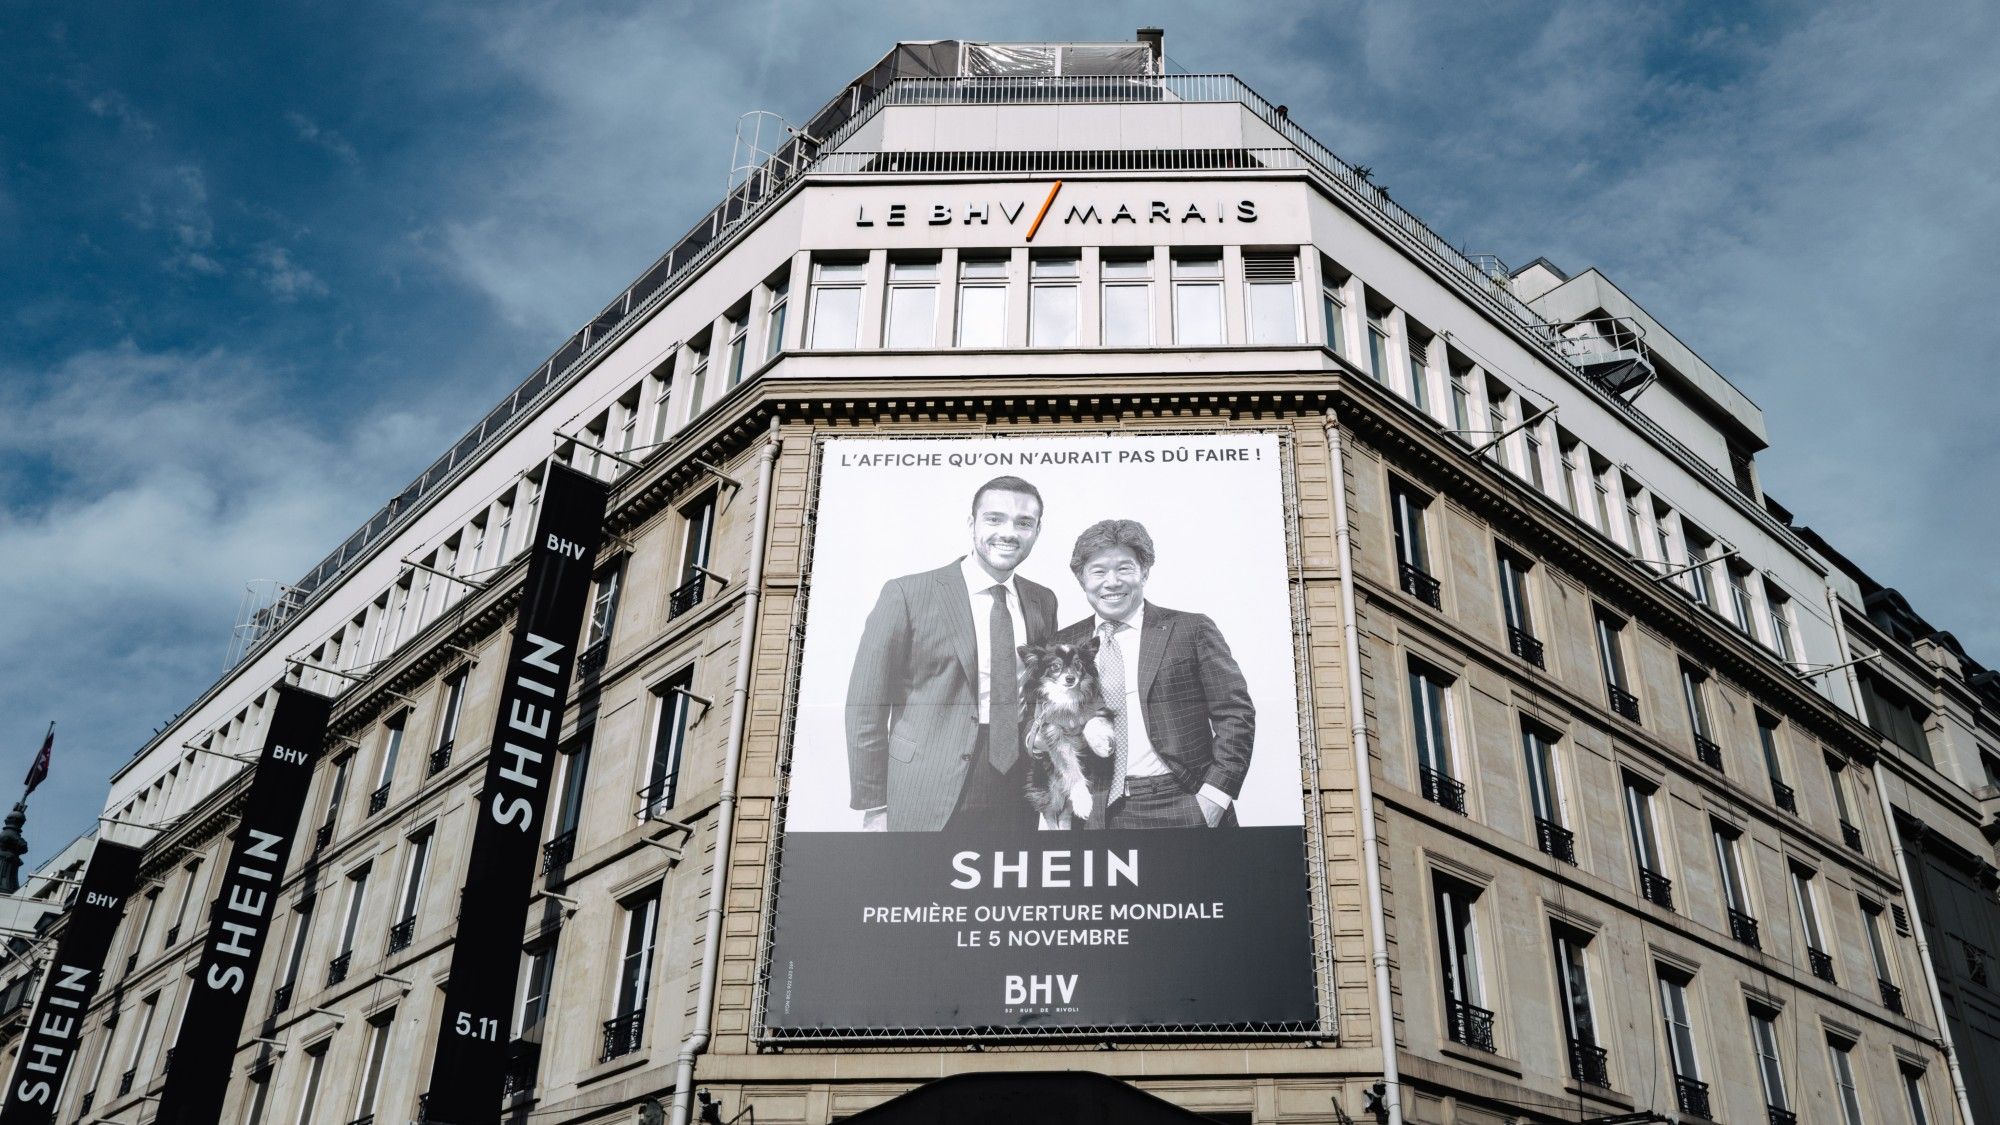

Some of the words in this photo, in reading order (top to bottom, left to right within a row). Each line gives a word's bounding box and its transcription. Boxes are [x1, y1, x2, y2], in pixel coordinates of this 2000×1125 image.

[856, 204, 906, 227] LE
[841, 453, 942, 467] L'AFFICHE
[948, 453, 1013, 467] QU'ON
[1020, 451, 1112, 465] N'AURAIT
[1119, 450, 1155, 463] PAS
[1162, 446, 1189, 462] DÛ
[1195, 448, 1249, 462] FAIRE
[546, 533, 586, 561] BHV
[492, 632, 566, 833] SHEIN
[272, 744, 309, 766] BHV
[950, 849, 1139, 890] SHEIN
[86, 891, 118, 909] BHV
[207, 829, 284, 995] SHEIN
[863, 901, 968, 923] PREMIÈRE
[974, 904, 1103, 923] OUVERTURE
[1110, 902, 1224, 920] MONDIALE
[956, 930, 982, 948] LE
[988, 930, 1001, 947] 5
[1008, 928, 1129, 947] NOVEMBRE
[1004, 974, 1079, 1005] BHV
[18, 964, 92, 1106] SHEIN
[455, 1011, 498, 1041] 5.11
